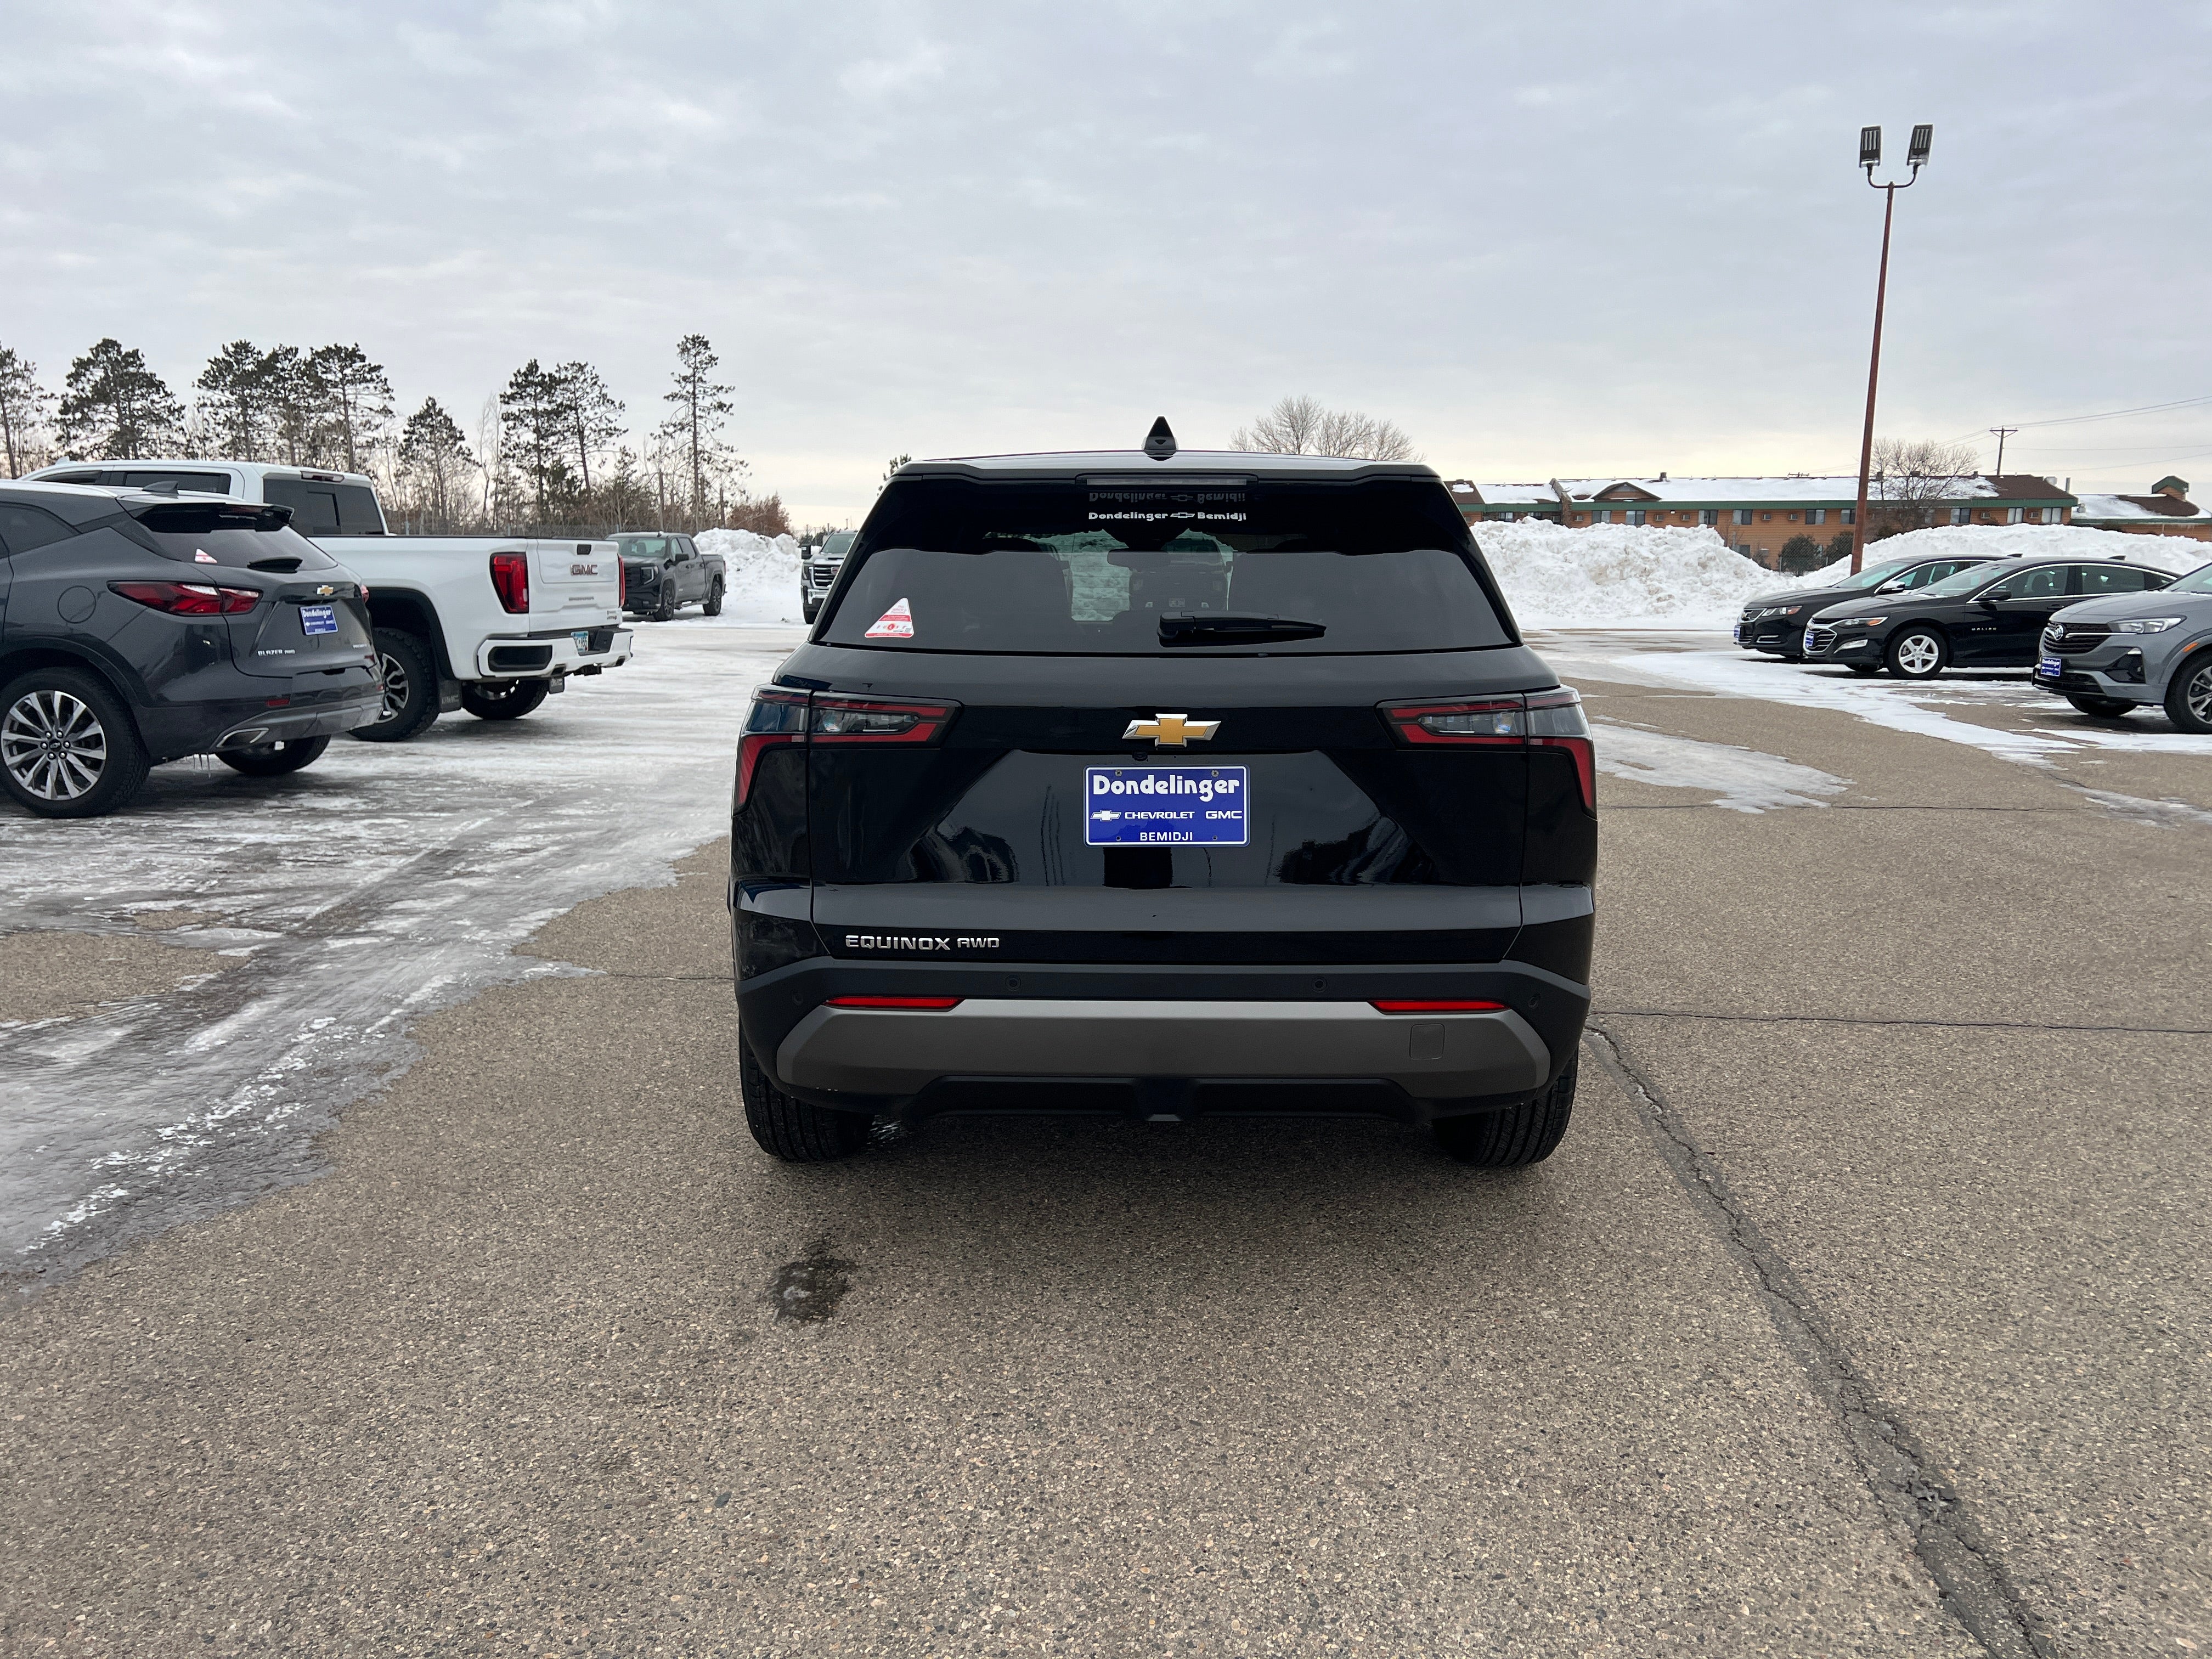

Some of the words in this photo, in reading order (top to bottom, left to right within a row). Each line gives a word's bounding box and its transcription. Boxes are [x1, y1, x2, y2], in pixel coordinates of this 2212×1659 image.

[1088, 511, 1169, 521] Dondelinger
[1197, 511, 1246, 521] Bemidji
[571, 563, 598, 575] GMC
[1093, 774, 1240, 802] Dondelinger
[1124, 811, 1195, 819] CHEVROLET
[1205, 810, 1243, 819] GMC
[1139, 832, 1193, 841] BEMIDJI
[845, 935, 951, 950] EQUINOX
[957, 937, 1000, 948] AWD
